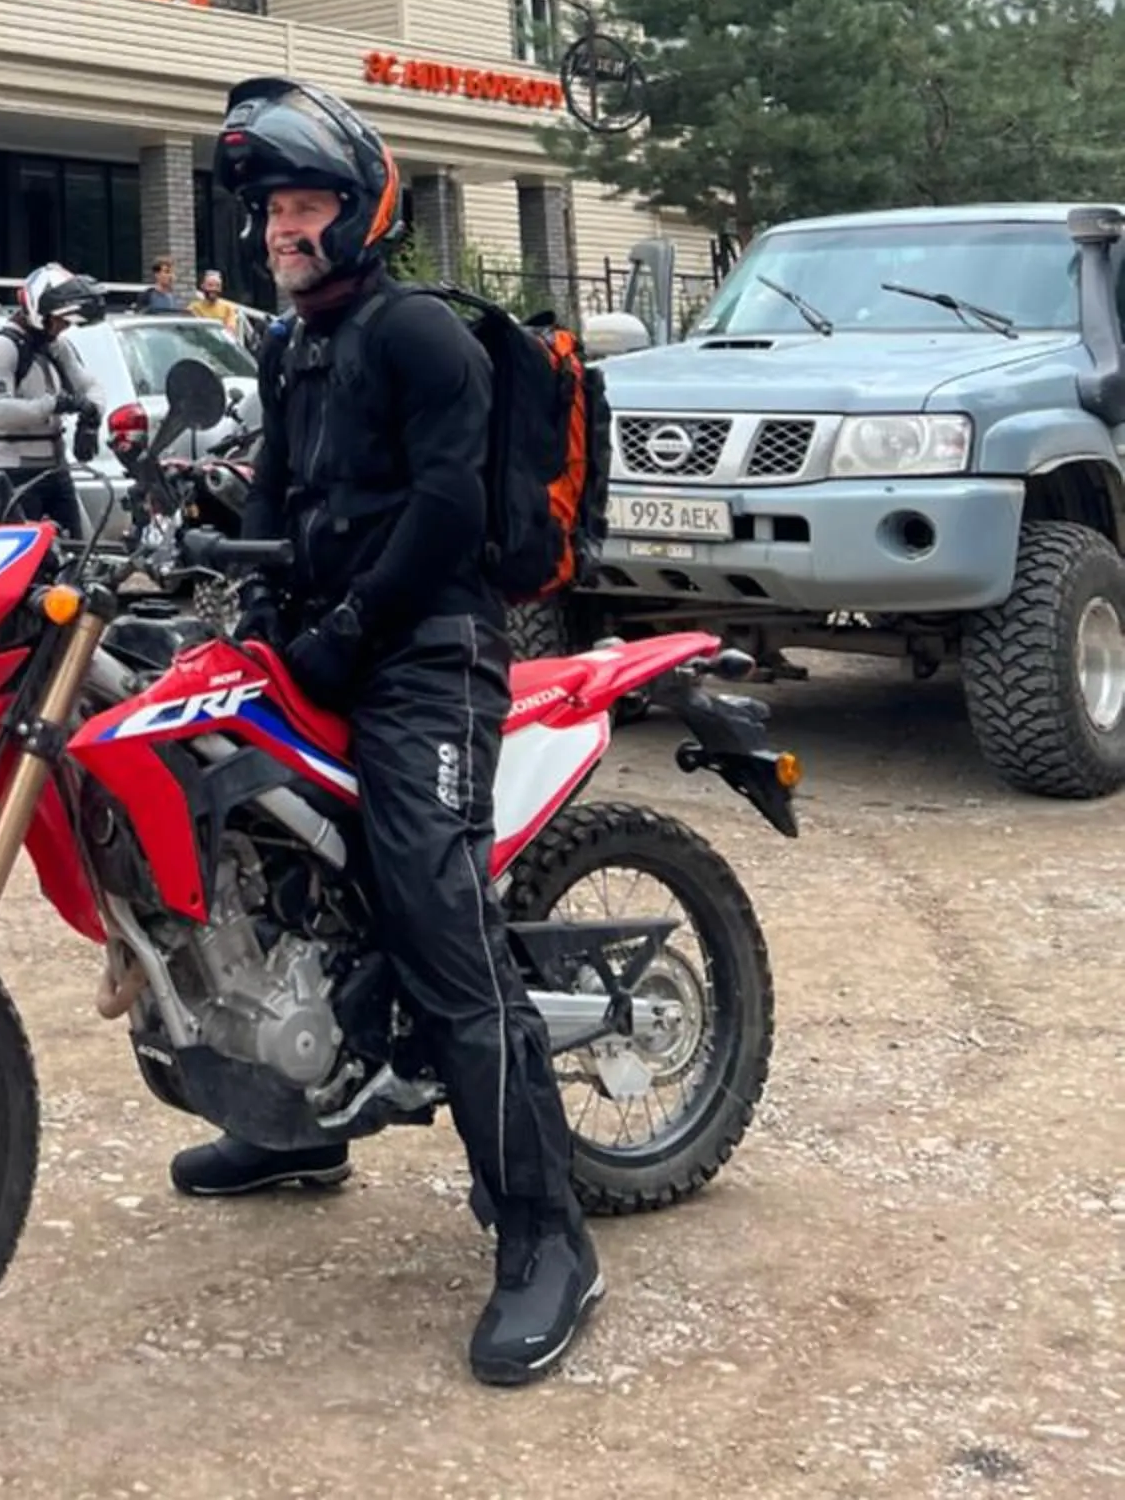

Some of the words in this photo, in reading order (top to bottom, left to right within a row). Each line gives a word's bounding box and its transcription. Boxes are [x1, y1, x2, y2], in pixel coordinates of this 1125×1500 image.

[631, 501, 674, 527] 993
[680, 507, 720, 530] AEK
[114, 679, 269, 739] CRF
